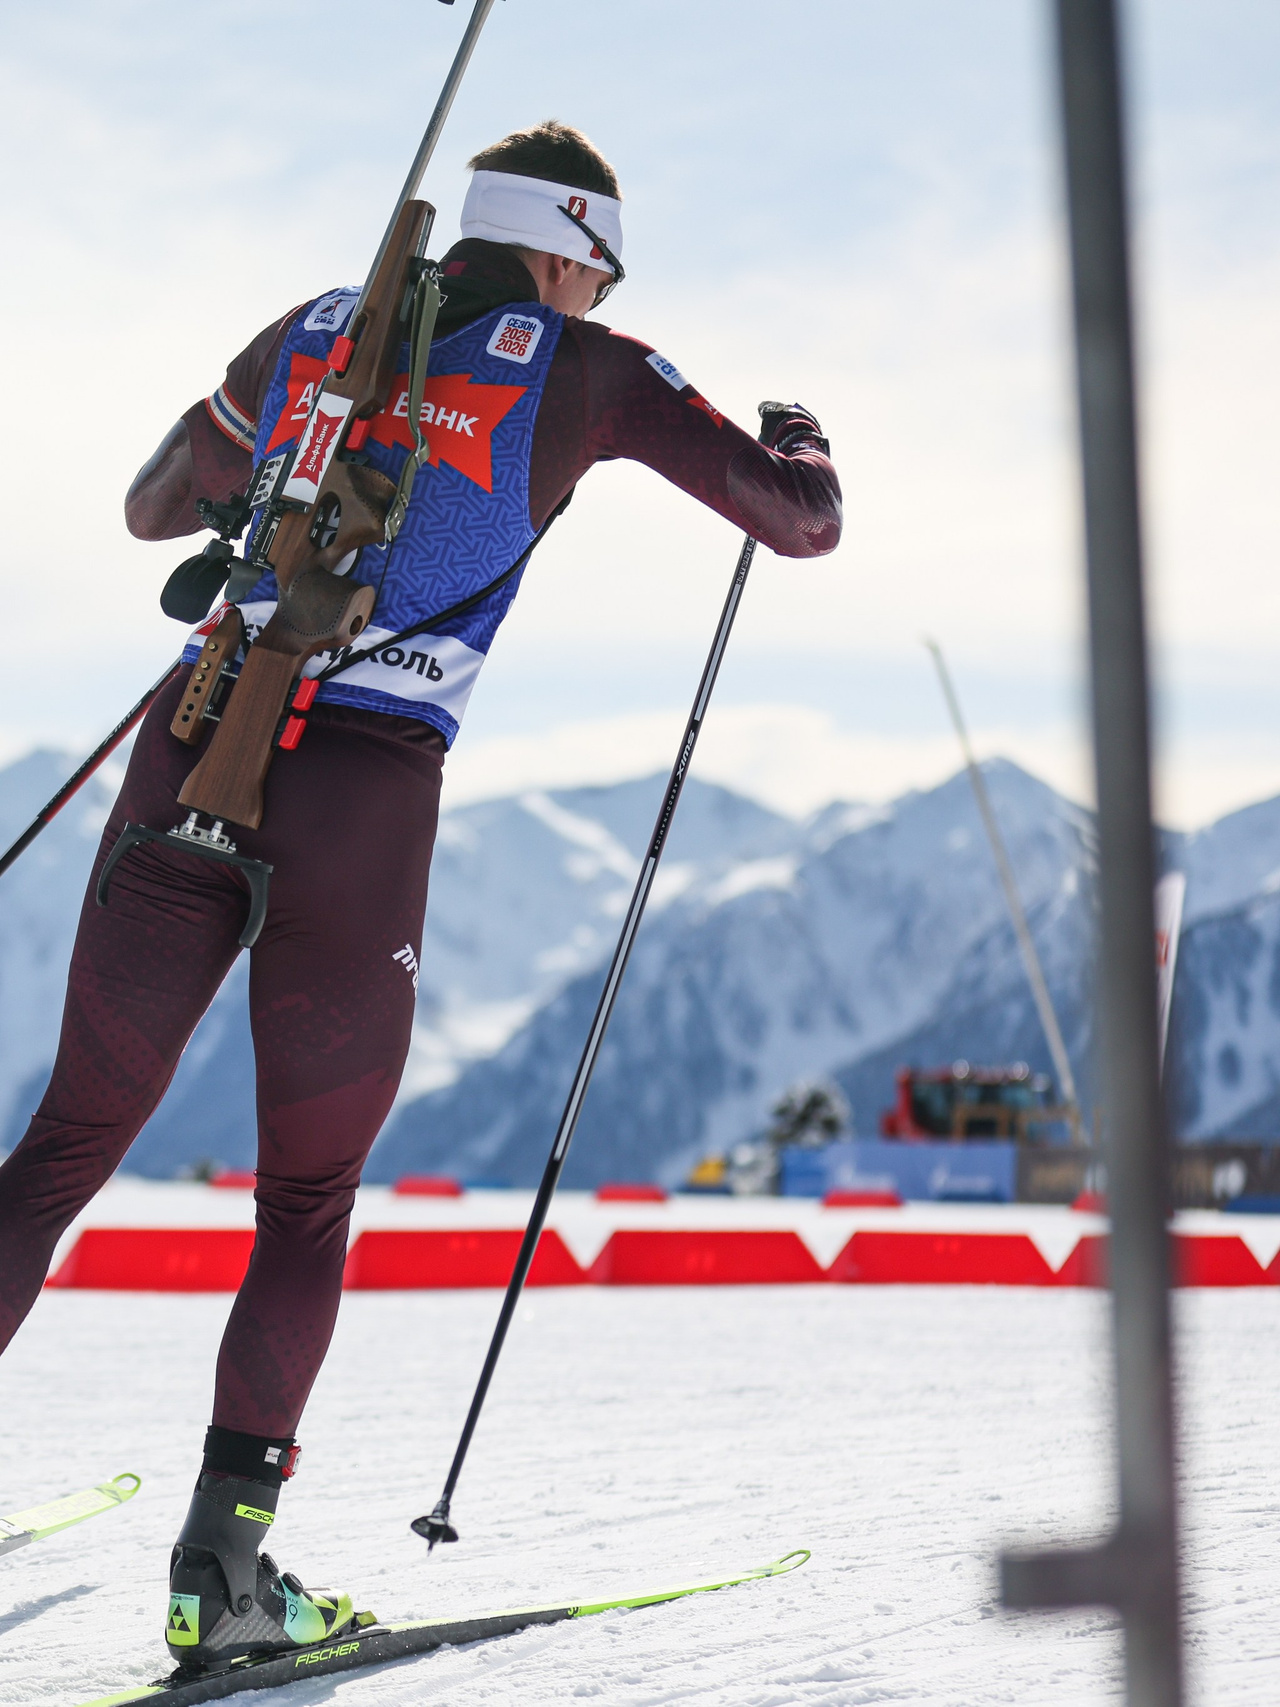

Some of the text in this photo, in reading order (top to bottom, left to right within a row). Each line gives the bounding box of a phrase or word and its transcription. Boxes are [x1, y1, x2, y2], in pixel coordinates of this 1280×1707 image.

[500, 326, 533, 344] 2025
[506, 317, 538, 333] СЕЗОН
[494, 338, 528, 357] 2026
[391, 390, 480, 438] Банк
[305, 423, 330, 473] Альфа Банк
[654, 782, 679, 851] AERODYNAMICS
[294, 1641, 360, 1668] FISCHER
